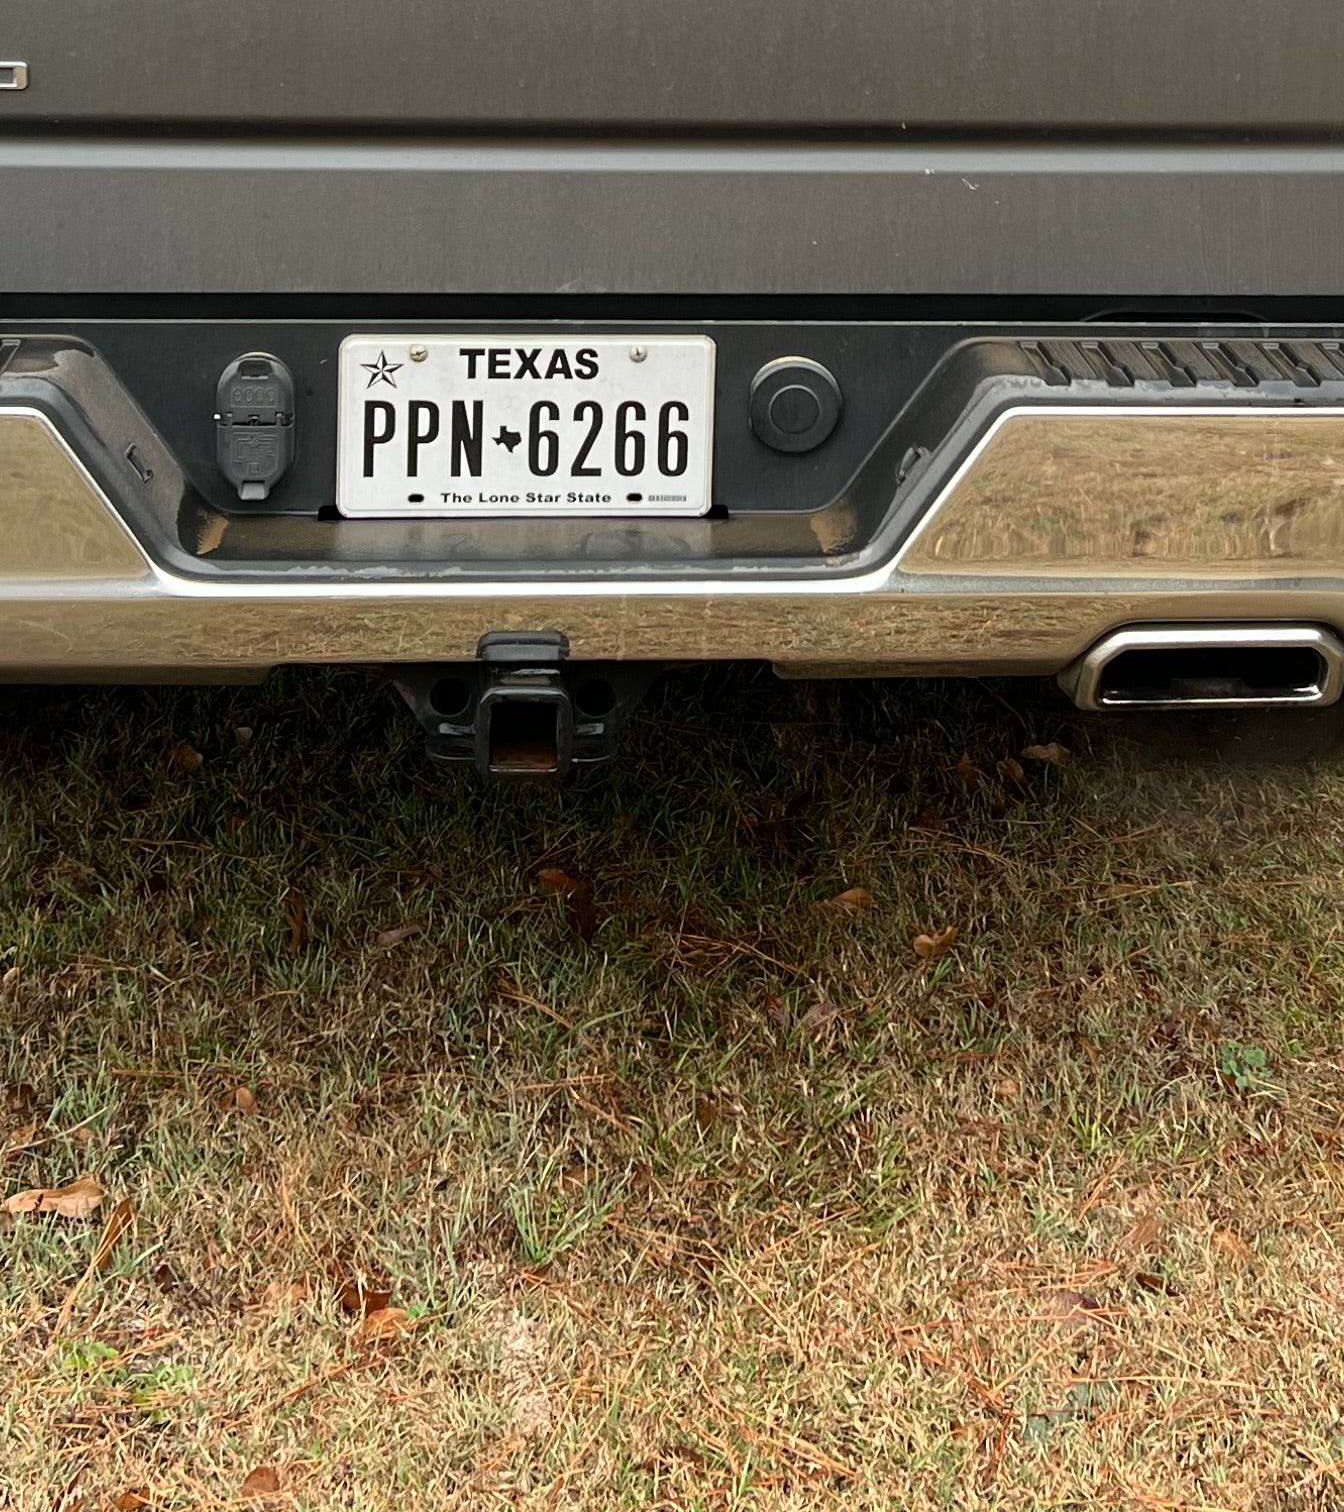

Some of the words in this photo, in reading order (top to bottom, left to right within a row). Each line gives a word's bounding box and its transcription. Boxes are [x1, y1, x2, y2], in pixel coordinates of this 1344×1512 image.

[459, 348, 599, 380] TEXAS
[440, 491, 473, 504] The
[478, 491, 520, 504] Lone
[525, 491, 562, 504] Star
[566, 491, 612, 504] State
